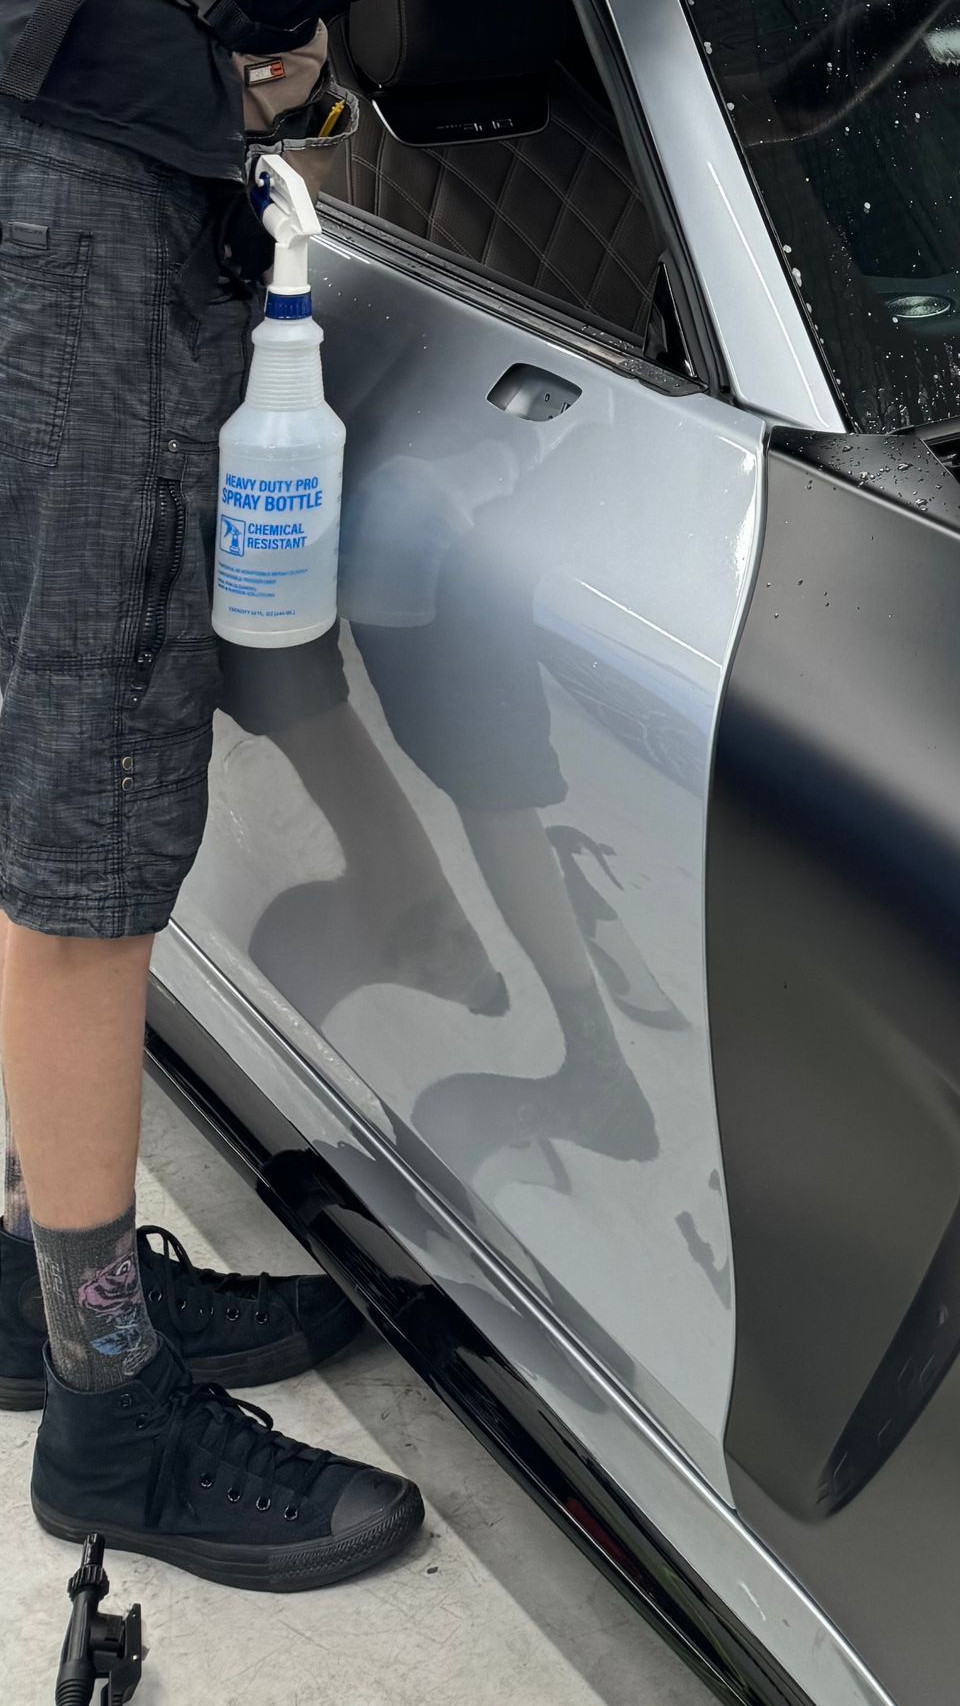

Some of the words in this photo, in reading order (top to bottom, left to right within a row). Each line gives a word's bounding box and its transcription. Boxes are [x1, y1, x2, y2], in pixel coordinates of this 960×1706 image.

[225, 473, 257, 491] HEAVY
[259, 480, 292, 493] DUTY
[295, 476, 319, 492] PRO
[222, 487, 260, 511] SPRAY
[264, 491, 323, 512] BOTTLE
[248, 523, 305, 536] CHEMICAL
[247, 536, 308, 550] RESISTANT
